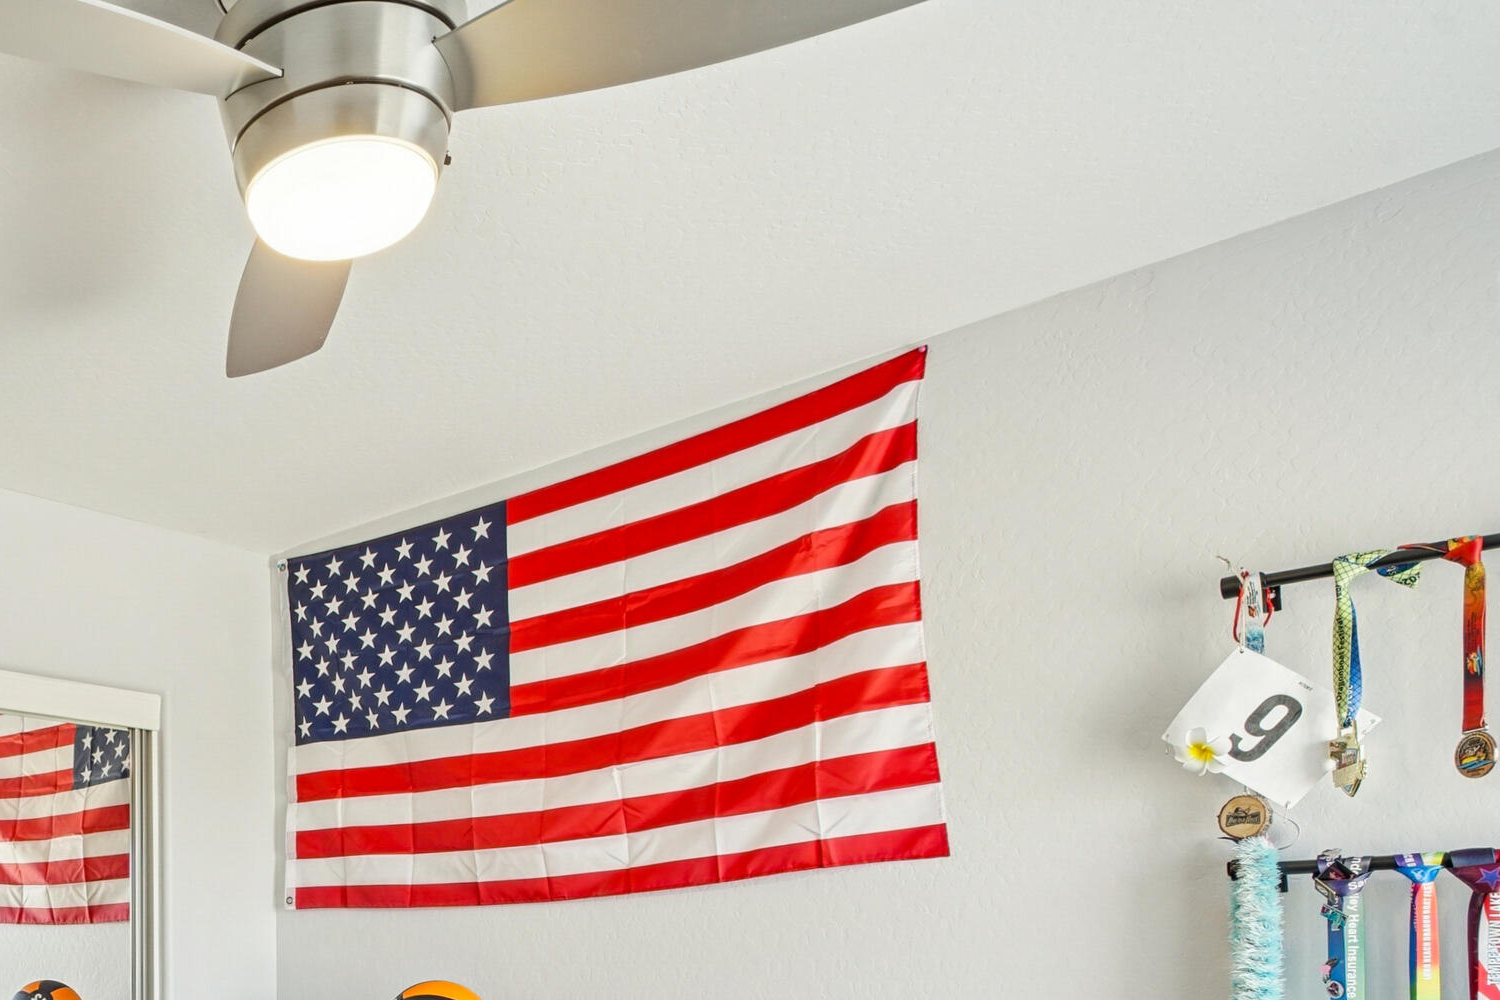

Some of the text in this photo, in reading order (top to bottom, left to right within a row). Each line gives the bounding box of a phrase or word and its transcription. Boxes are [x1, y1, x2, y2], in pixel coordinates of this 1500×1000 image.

[1335, 617, 1345, 701] Dragonboat Festival
[1228, 694, 1303, 762] 9
[1489, 891, 1500, 917] LAKE
[1348, 914, 1359, 943] Heart
[1488, 919, 1500, 950] TOWN
[1347, 946, 1359, 998] Insurance
